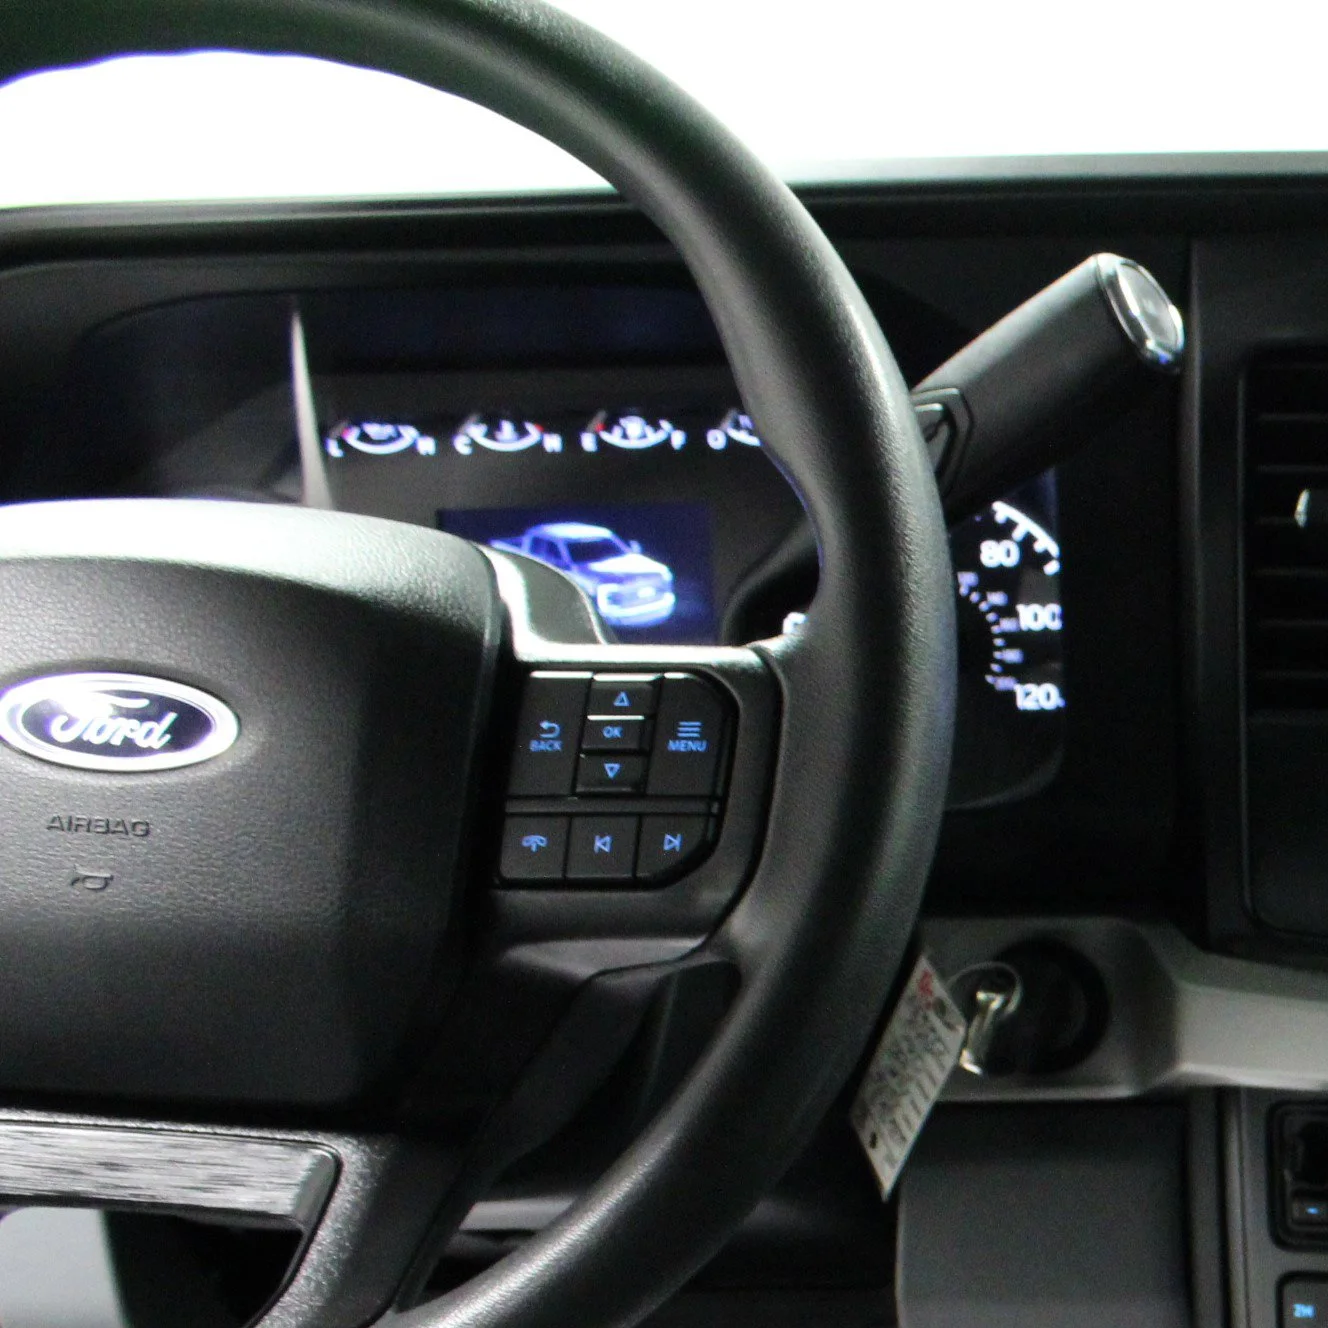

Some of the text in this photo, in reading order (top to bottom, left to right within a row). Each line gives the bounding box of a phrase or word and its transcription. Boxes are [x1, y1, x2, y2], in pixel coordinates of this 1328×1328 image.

[979, 540, 1020, 568] 80
[1015, 683, 1058, 710] 120
[48, 700, 172, 751] Ford
[603, 726, 622, 738] OK
[530, 740, 563, 752] BACK
[668, 740, 707, 752] MENU
[45, 814, 151, 838] AIRBAG
